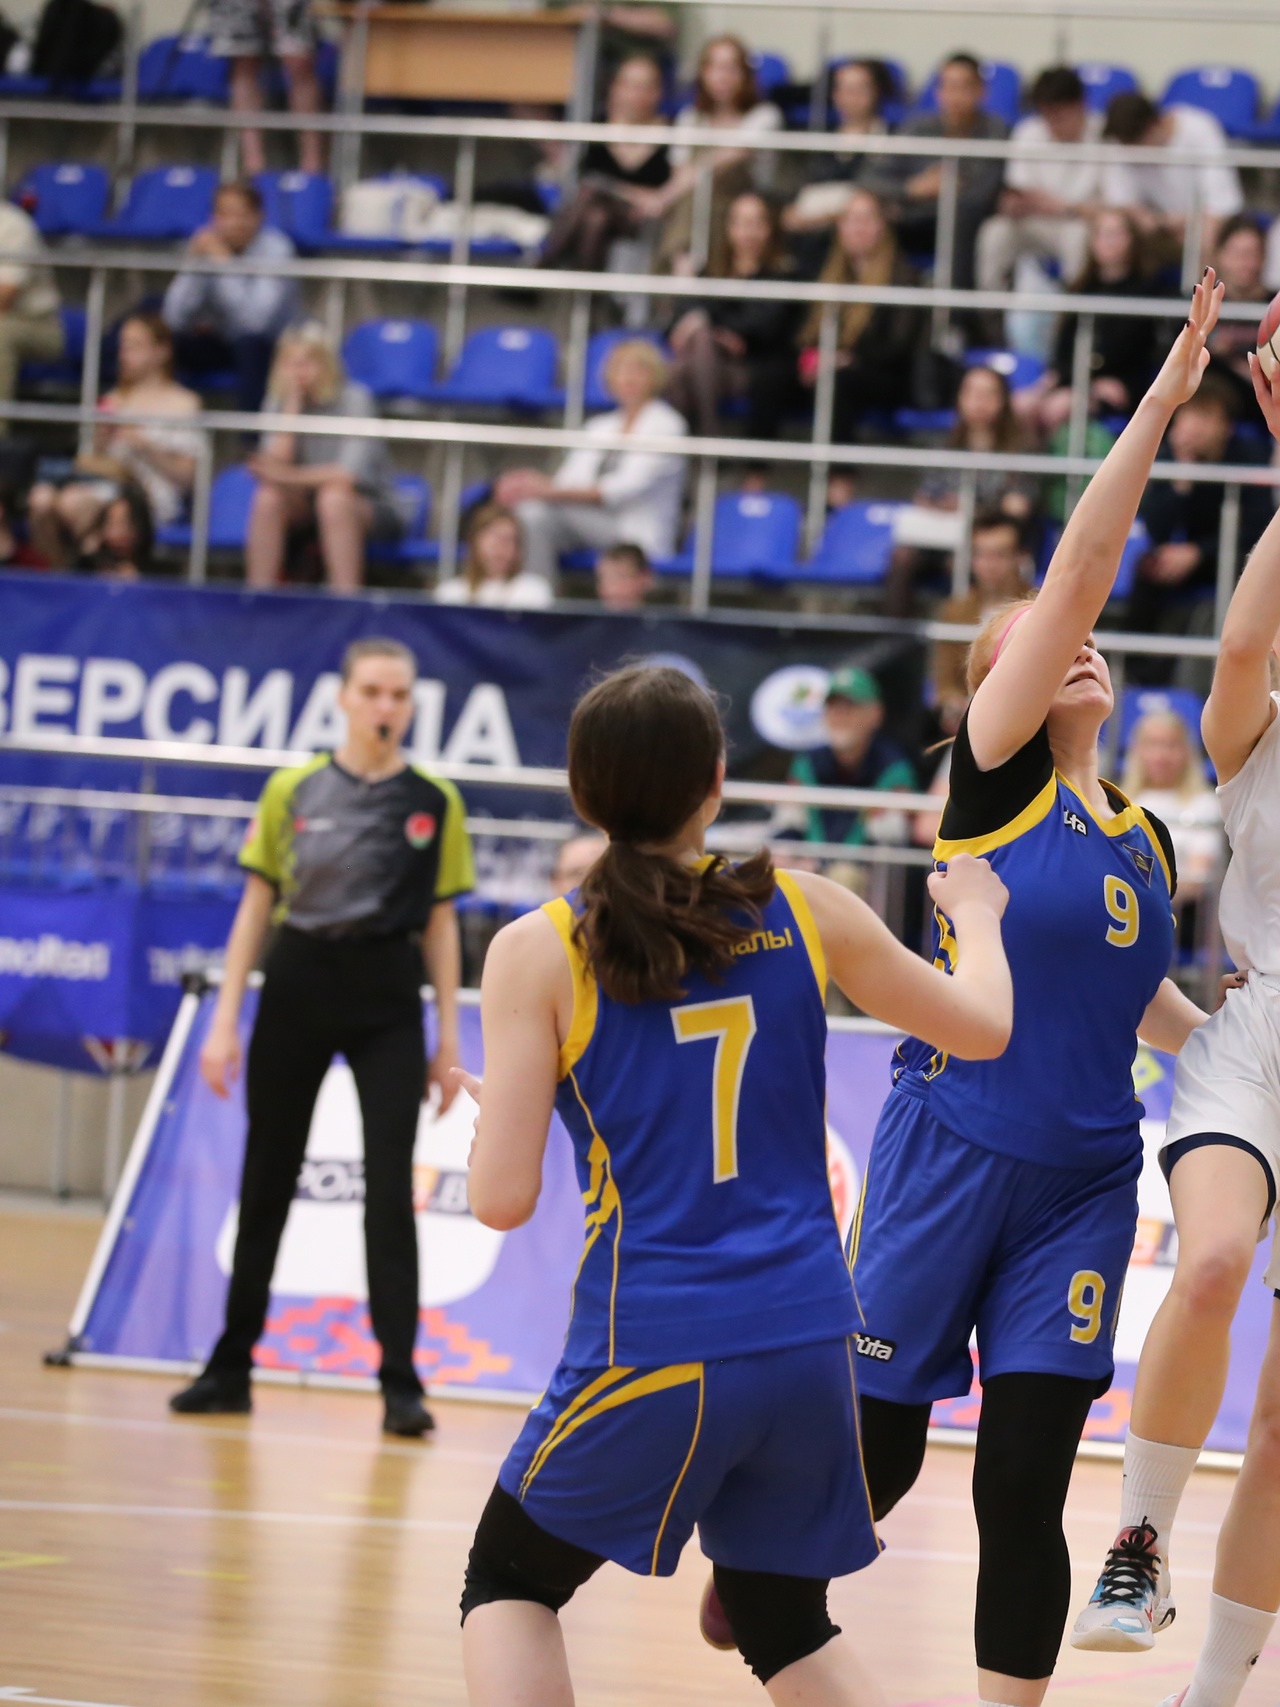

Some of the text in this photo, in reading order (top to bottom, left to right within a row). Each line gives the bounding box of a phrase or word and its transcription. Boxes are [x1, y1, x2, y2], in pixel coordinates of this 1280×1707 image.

[1103, 874, 1140, 948] 9
[670, 994, 757, 1184] 7
[1067, 1269, 1106, 1344] 9
